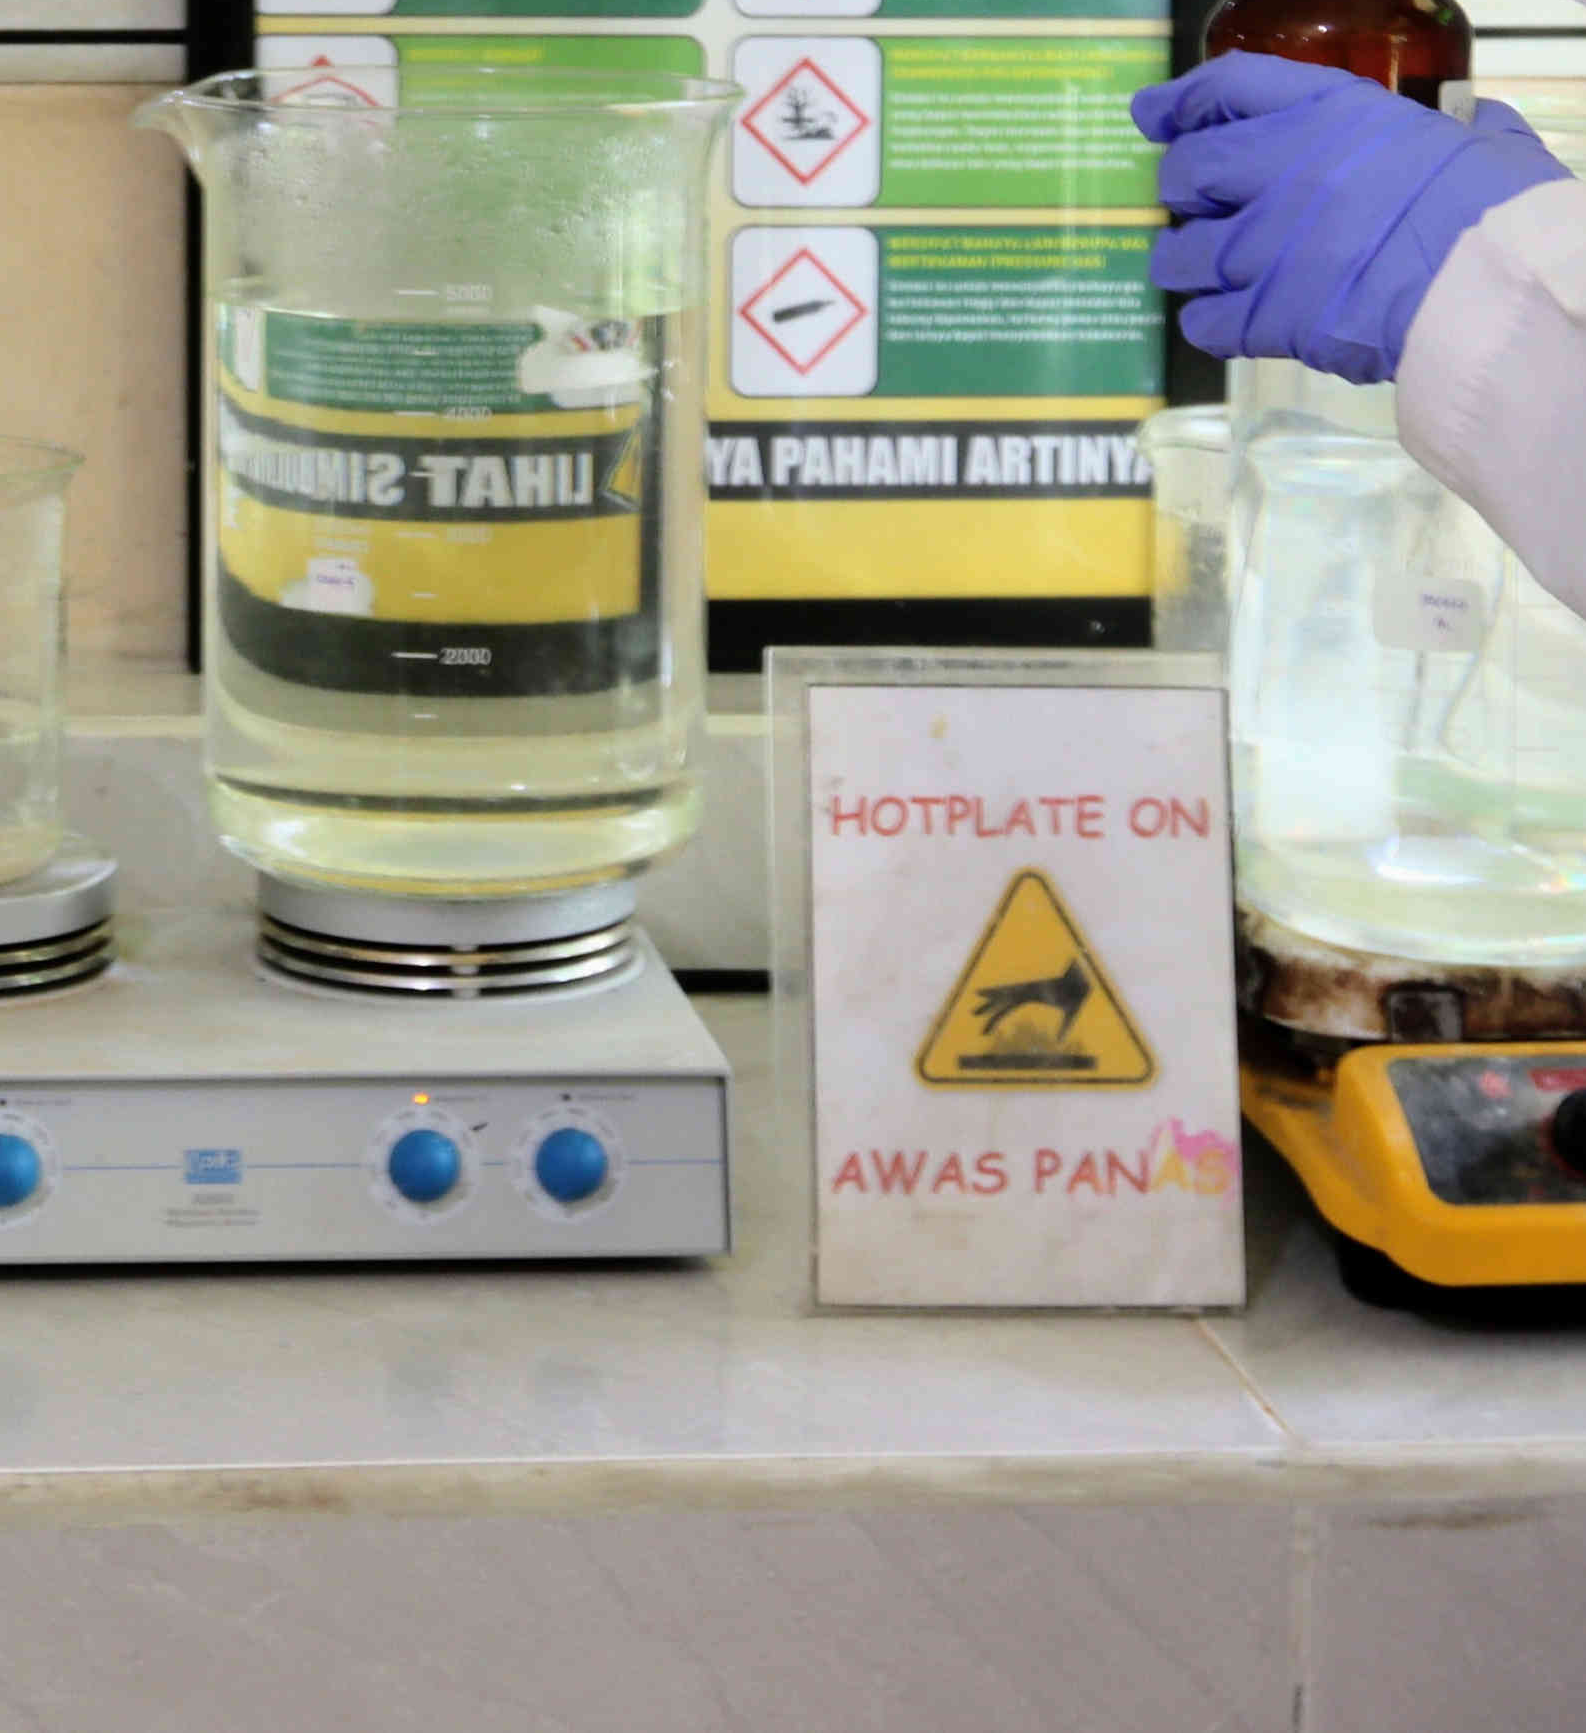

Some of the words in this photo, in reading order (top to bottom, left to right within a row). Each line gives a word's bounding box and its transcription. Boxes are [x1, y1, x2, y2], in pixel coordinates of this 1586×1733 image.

[770, 436, 957, 486] PAHAMI
[440, 647, 492, 665] 2000
[832, 795, 1104, 838] HOTPLATE
[1129, 797, 1211, 839] ON
[831, 1149, 1008, 1194] AWAS
[1034, 1146, 1232, 1195] PANAS
